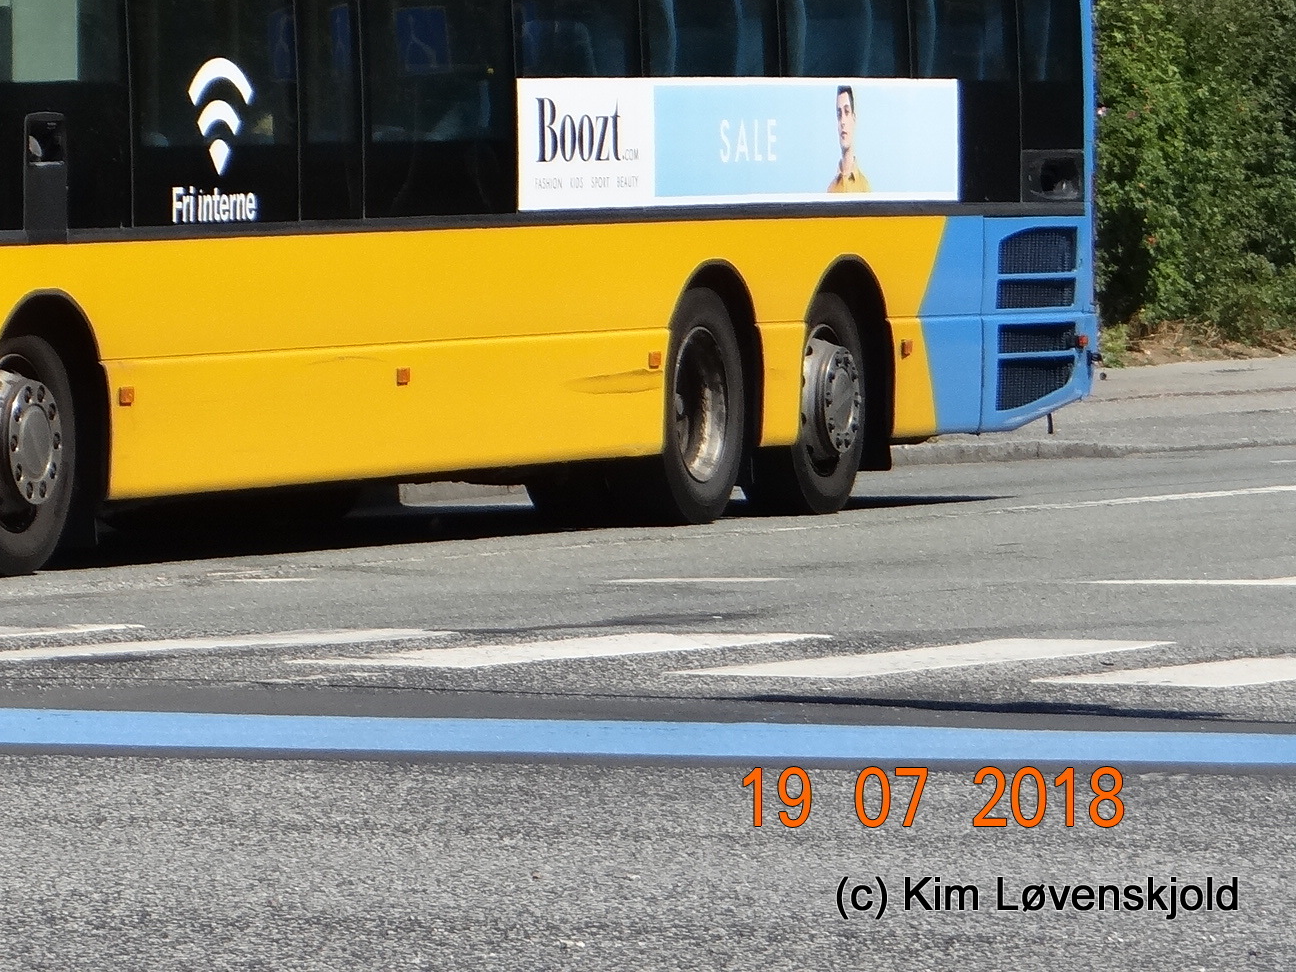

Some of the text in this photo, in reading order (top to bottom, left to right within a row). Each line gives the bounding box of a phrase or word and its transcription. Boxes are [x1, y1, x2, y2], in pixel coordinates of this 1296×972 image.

[719, 118, 777, 163] SALE
[534, 175, 640, 190] FASHION KIDS SPORT BEAUTY
[171, 185, 258, 223] Fri interne
